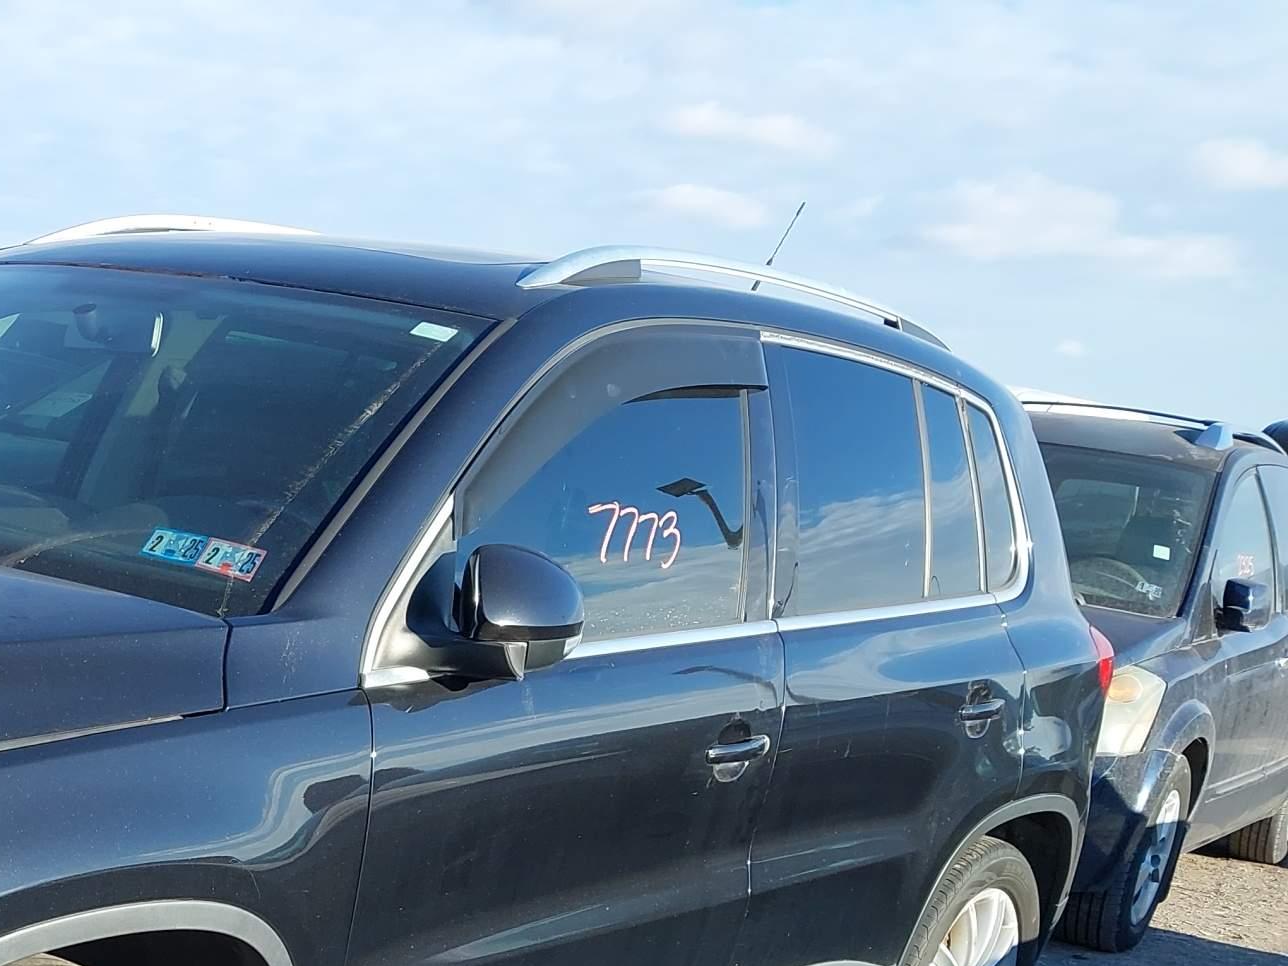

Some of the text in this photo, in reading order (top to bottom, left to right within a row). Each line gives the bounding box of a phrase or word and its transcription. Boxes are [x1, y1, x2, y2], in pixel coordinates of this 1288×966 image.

[149, 535, 204, 561] 2 25
[588, 501, 681, 569] 7773
[204, 547, 261, 574] 2 25
